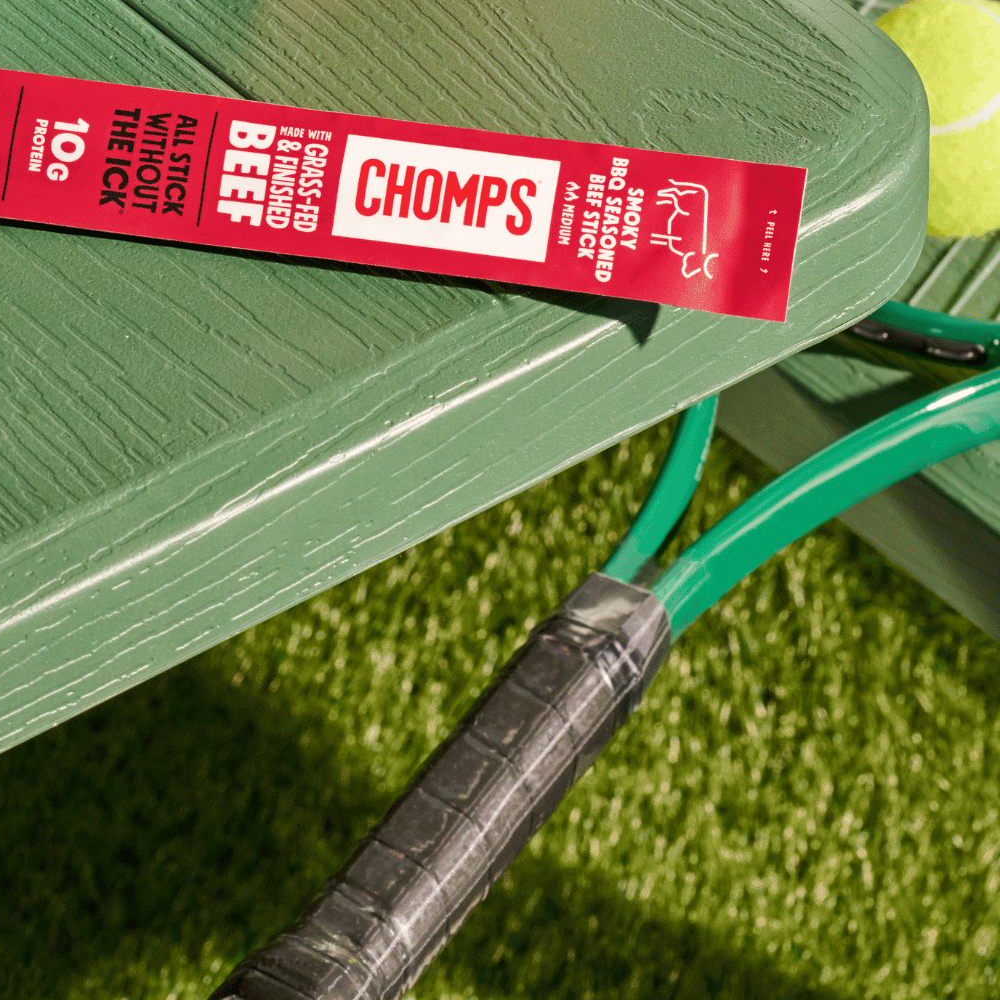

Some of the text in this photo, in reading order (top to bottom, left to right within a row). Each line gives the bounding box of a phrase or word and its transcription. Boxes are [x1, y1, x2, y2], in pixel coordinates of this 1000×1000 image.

[29, 119, 48, 172] PROTEIN
[47, 118, 89, 181] 10G
[99, 108, 141, 208] THE ICK
[132, 113, 172, 213] WITHOUT
[162, 114, 198, 216] ALL STICK
[217, 120, 276, 226] BEEF
[280, 126, 332, 141] MADE WITH
[266, 140, 302, 228] & FINISHED
[293, 144, 328, 232] GRASS-FED
[355, 159, 536, 235] CHOMPS
[558, 204, 575, 245] MEDIUM
[578, 174, 606, 259] BEEF STICK
[595, 157, 629, 282] BBQ SEASONED
[620, 188, 644, 250] SMOKY
[762, 222, 775, 261] PEEL HERE
